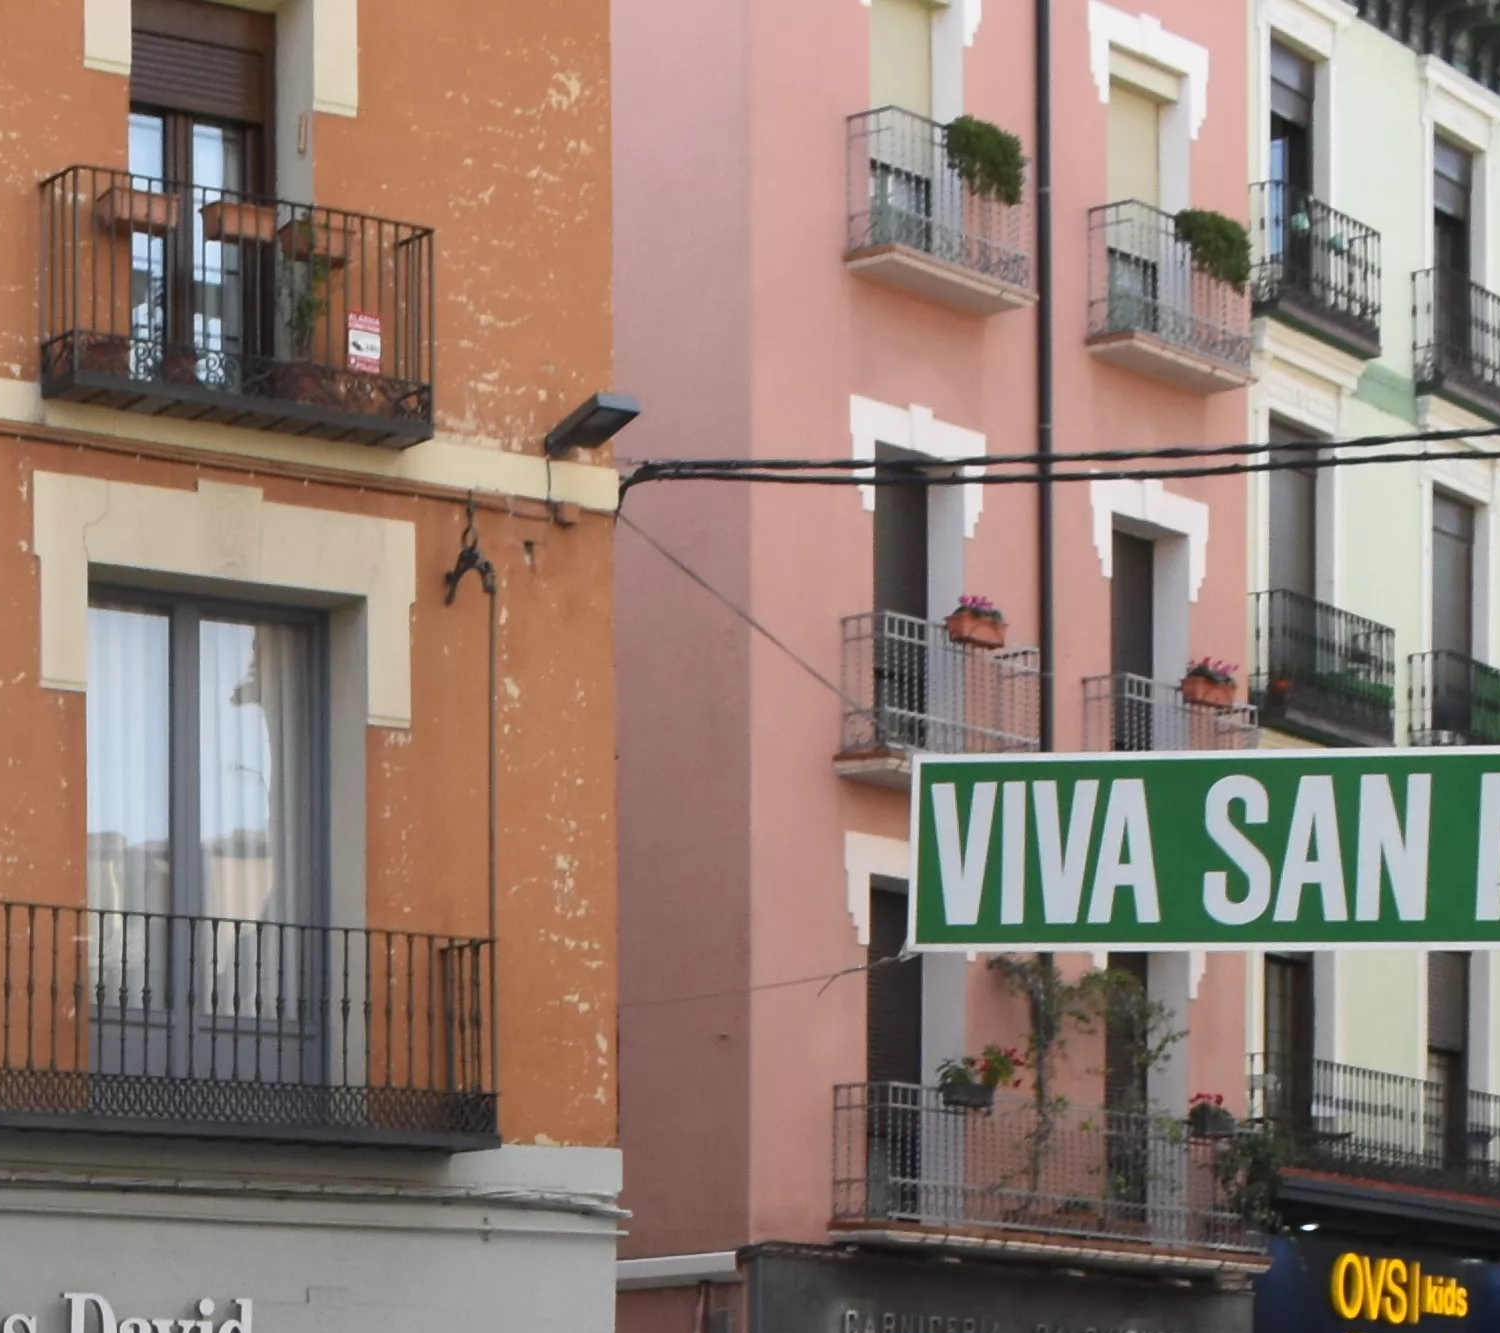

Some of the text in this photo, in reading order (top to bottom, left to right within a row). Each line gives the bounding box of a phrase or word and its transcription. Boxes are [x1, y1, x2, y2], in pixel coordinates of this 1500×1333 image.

[931, 779, 1160, 926] VIVA
[1203, 773, 1432, 926] SAN
[1331, 1252, 1468, 1325] OVS kids
